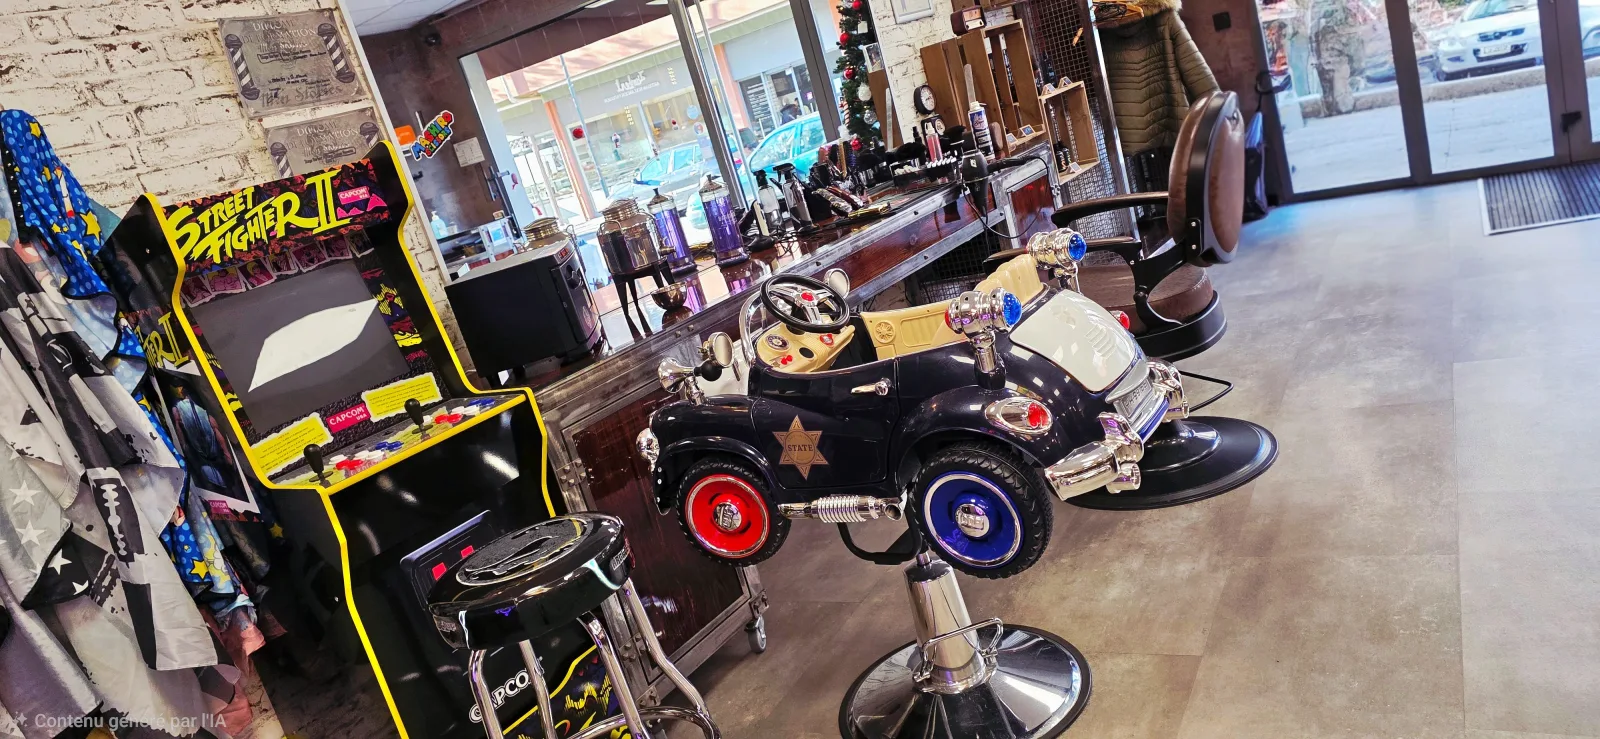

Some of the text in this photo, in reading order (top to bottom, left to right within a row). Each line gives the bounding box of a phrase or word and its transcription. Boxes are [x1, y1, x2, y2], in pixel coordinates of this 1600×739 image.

[411, 111, 453, 159] MASHIRO
[188, 169, 353, 264] FIGHTER II
[339, 188, 367, 199] CAPCOM
[166, 186, 254, 259] STREET
[329, 406, 365, 425] CAPCOM
[787, 444, 814, 452] STATE
[469, 660, 545, 723] CPCO
